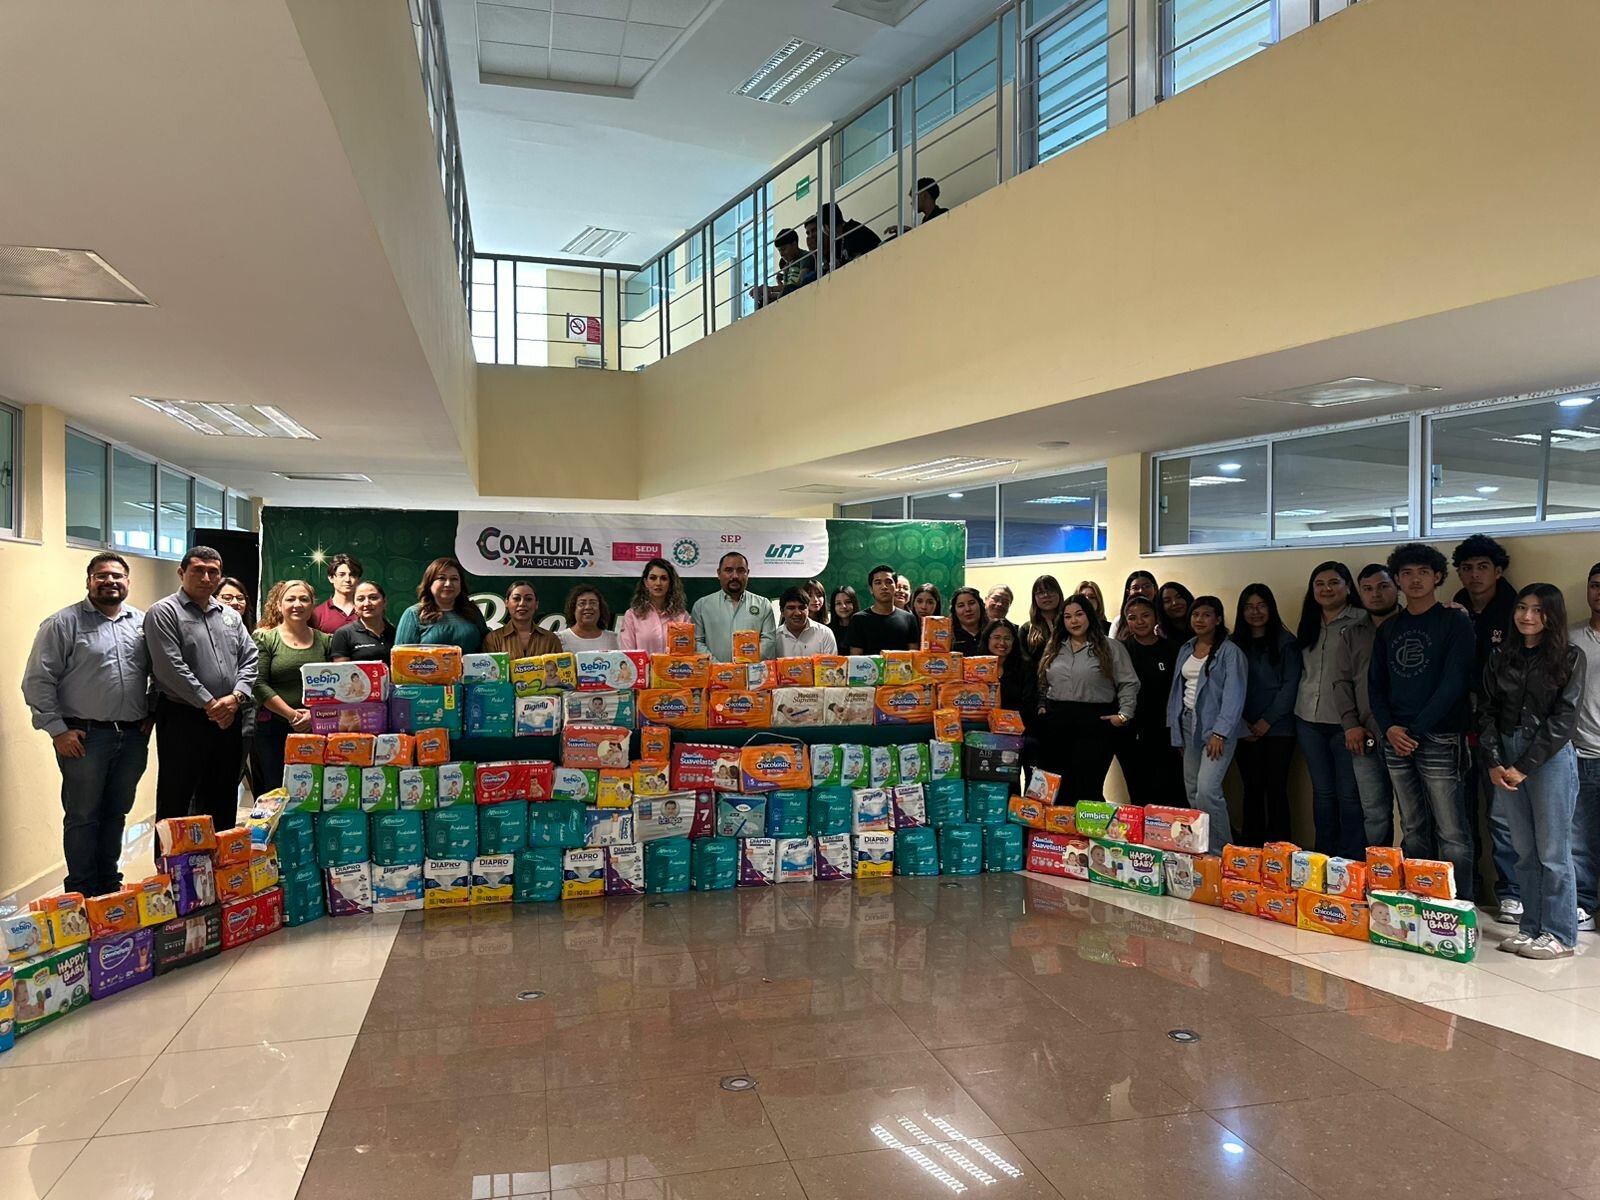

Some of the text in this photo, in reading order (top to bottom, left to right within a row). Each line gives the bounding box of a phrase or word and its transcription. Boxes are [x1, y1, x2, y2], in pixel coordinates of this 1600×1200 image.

[476, 527, 594, 560] COAHUILA
[720, 534, 742, 544] SEP
[635, 545, 659, 553] SEDU
[765, 543, 805, 558] UTP
[537, 558, 574, 569] DELANTE
[580, 659, 611, 671] Bebin
[305, 672, 340, 686] Bebin
[372, 671, 379, 679] 3
[524, 701, 549, 713] Dignity
[622, 704, 632, 716] 4
[316, 709, 338, 720] Depend
[316, 722, 338, 731] MUJER
[680, 757, 718, 767] Suavelastic
[756, 761, 791, 772] Chicolastic
[700, 809, 710, 822] 7
[864, 836, 889, 844] DIAPRO
[1032, 842, 1066, 854] Suavelastic
[479, 858, 509, 867] DIAPRO
[570, 852, 599, 861] DIAPRO
[1129, 850, 1156, 863] HAPPY
[430, 861, 460, 869] DIAPRO
[1133, 858, 1154, 869] BABY
[1312, 907, 1347, 922] Chicolastic
[1422, 909, 1459, 923] HAPPY
[10, 922, 32, 935] Bebin
[1428, 919, 1457, 932] BABY
[1444, 939, 1453, 950] G
[56, 950, 86, 974] HAPPY
[62, 963, 86, 985] BABY
